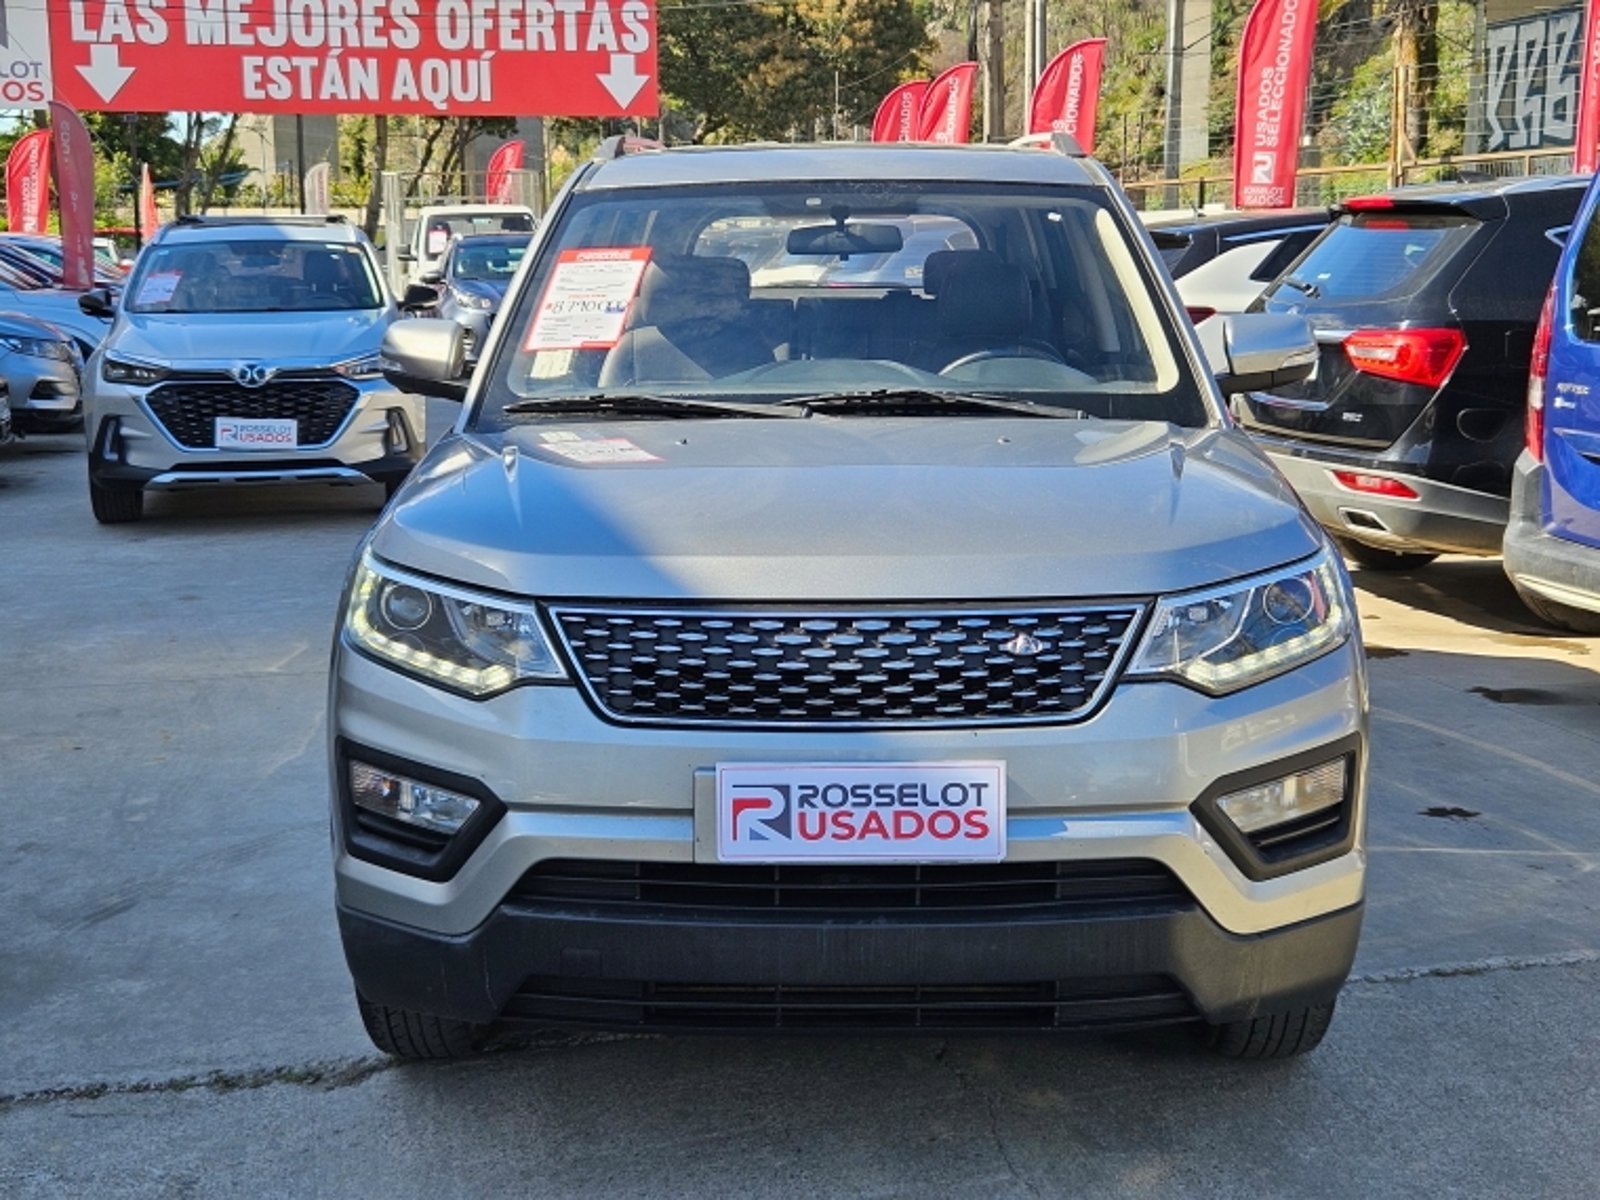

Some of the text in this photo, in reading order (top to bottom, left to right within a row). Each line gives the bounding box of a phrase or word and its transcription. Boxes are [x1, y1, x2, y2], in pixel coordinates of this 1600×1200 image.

[69, 0, 650, 53] LAS MEJORES OFERTAS
[242, 48, 496, 110] ESTÁN AQUÍ
[1254, 66, 1275, 147] USADOS
[239, 432, 293, 443] USADOS
[797, 783, 990, 809] ROSSELOT
[797, 810, 991, 841] USADOS
